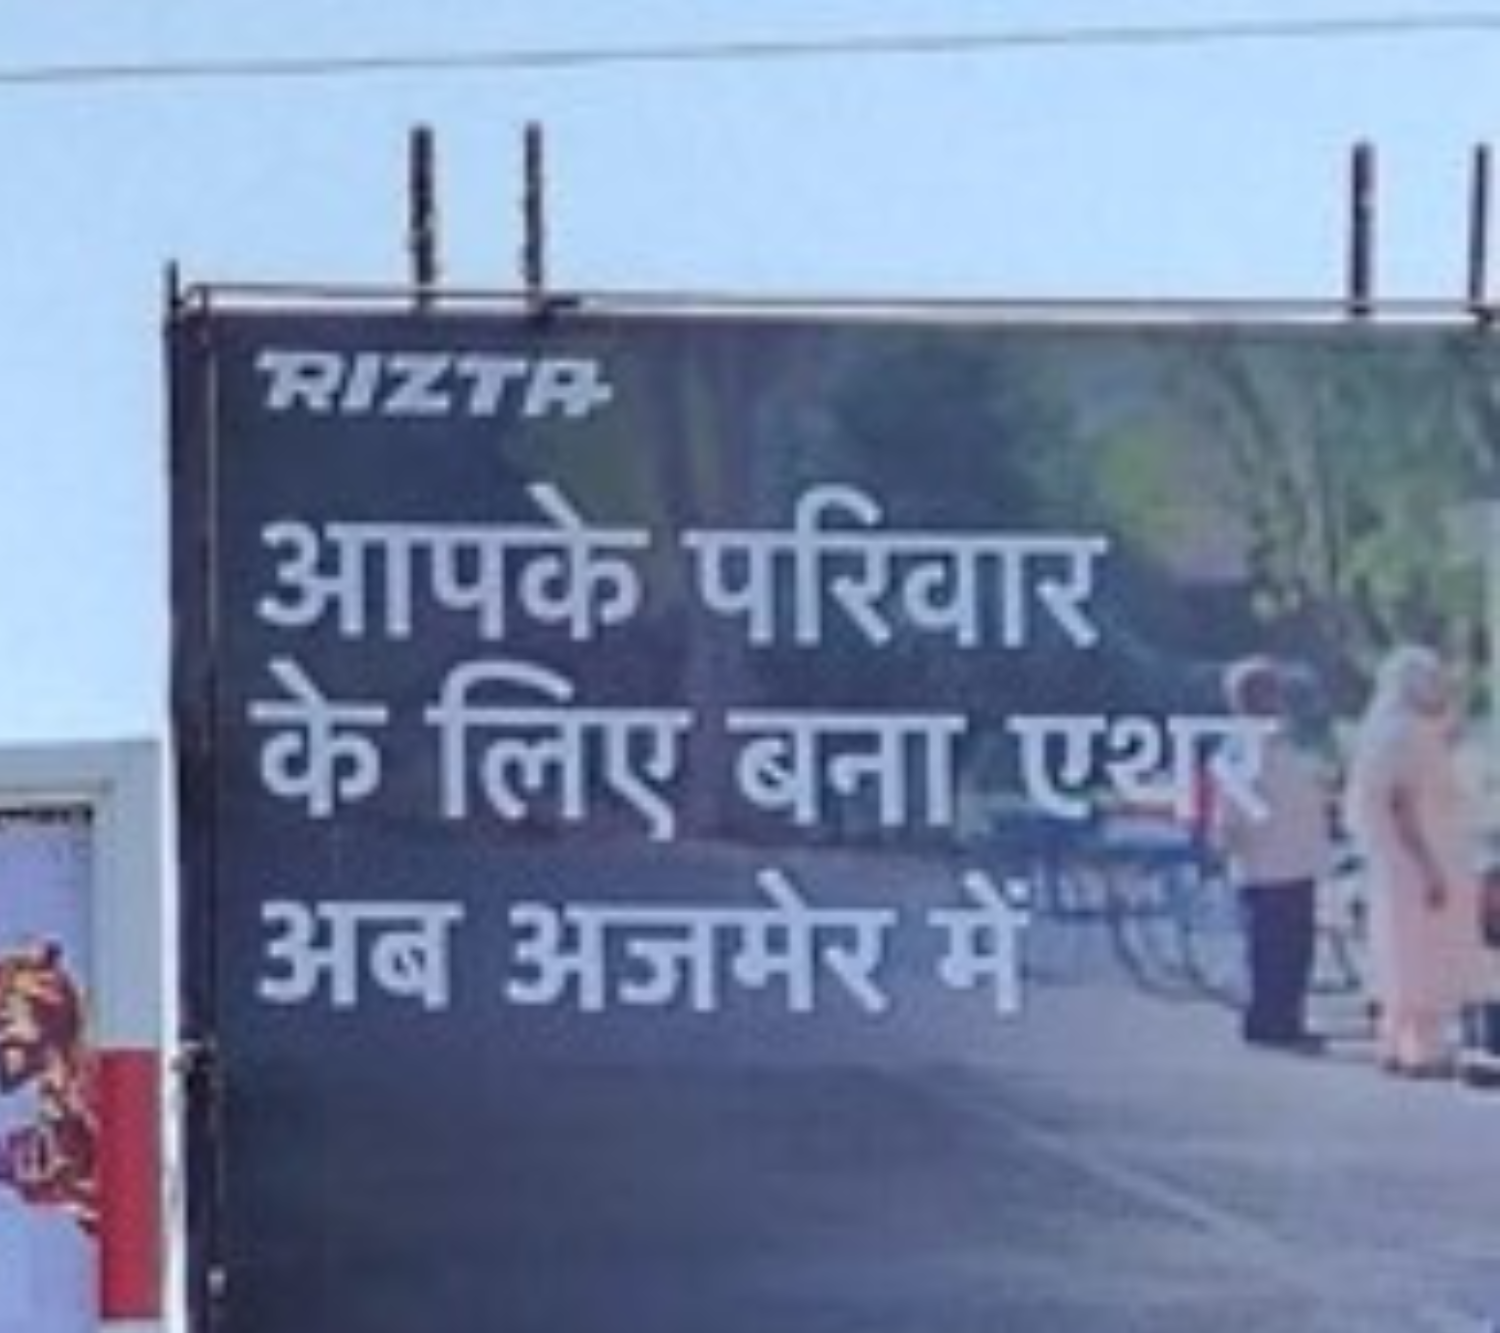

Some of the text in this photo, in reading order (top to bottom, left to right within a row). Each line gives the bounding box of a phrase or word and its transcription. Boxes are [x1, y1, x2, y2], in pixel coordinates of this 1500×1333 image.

[255, 350, 613, 417] RIZTA
[257, 483, 1107, 648] आपके परिवार
[248, 657, 1280, 842] के लिए बना एथर
[259, 868, 1030, 1012] अब अजमेर में
